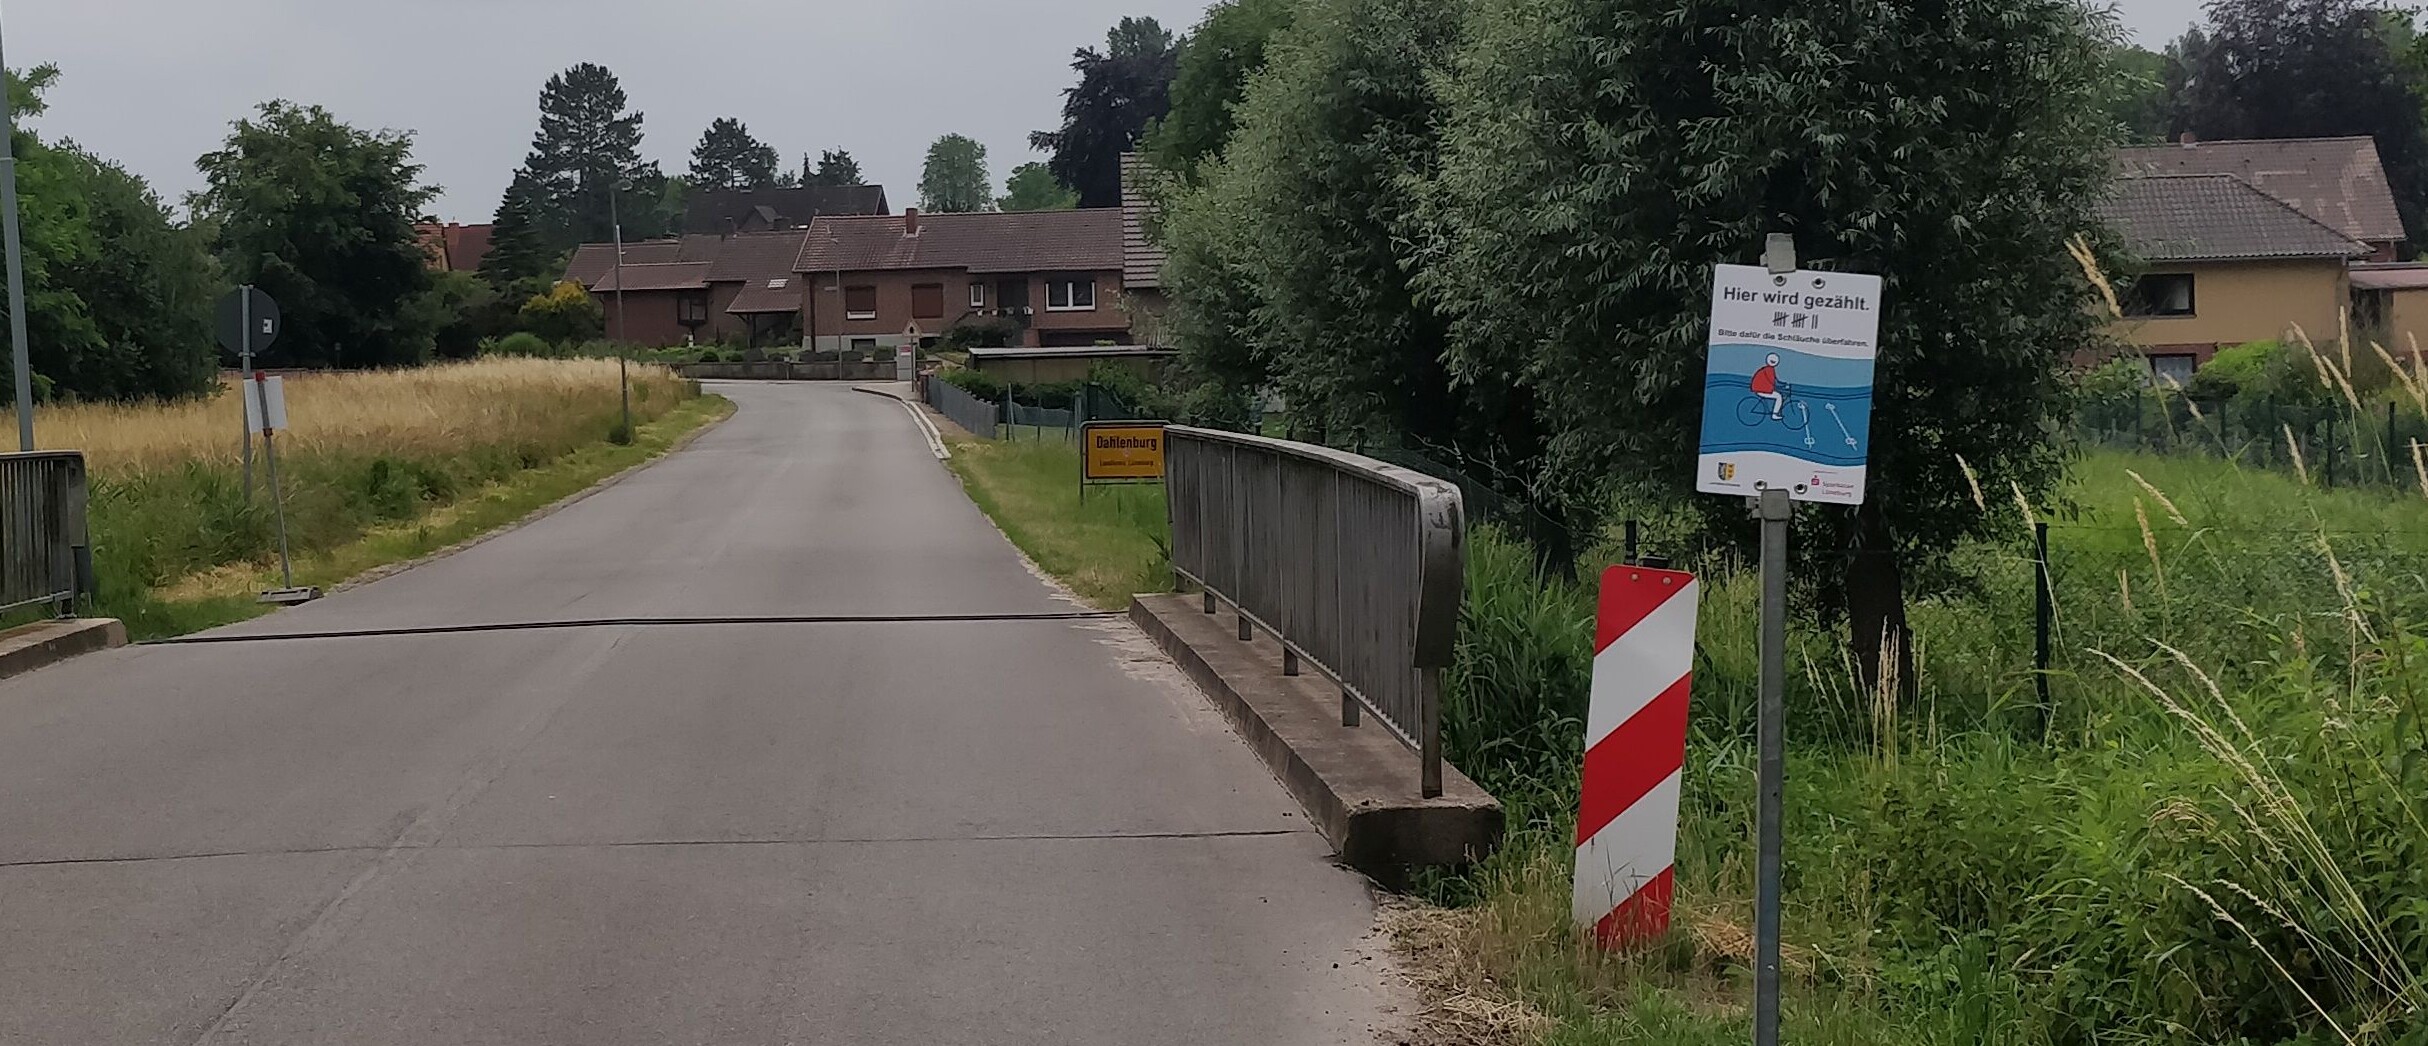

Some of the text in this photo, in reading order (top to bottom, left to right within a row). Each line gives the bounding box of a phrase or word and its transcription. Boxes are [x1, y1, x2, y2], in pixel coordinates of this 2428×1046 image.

[1724, 286, 1870, 311] Hier wird gezählt.
[1718, 329, 1738, 337] Bitte
[1739, 331, 1761, 339] dafür
[1778, 333, 1820, 344] Schläuche
[1096, 435, 1157, 452] Dahlenburg
